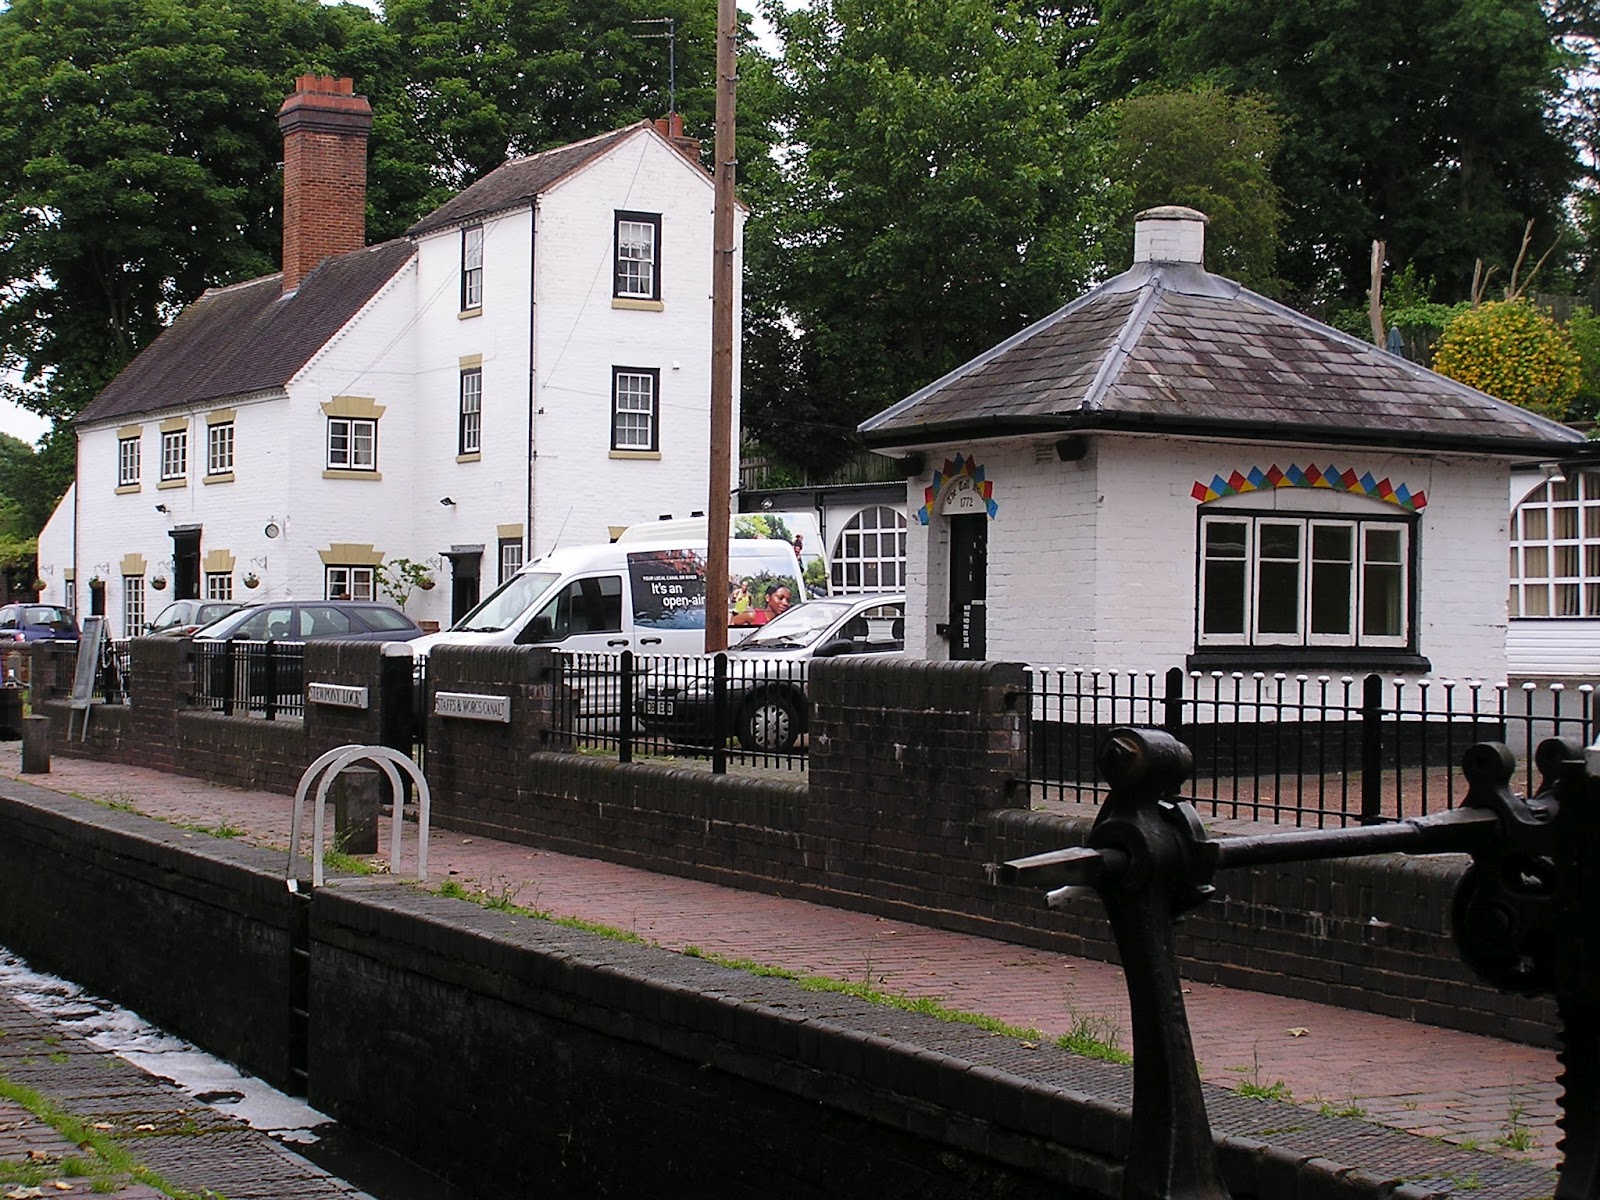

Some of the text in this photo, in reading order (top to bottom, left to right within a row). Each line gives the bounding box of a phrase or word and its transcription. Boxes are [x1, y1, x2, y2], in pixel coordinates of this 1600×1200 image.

[960, 496, 974, 508] 1772
[651, 582, 683, 594] It's an
[662, 593, 706, 609] open-air
[436, 697, 456, 712] STAFFS
[456, 699, 462, 712] &
[483, 701, 504, 716] CANAL
